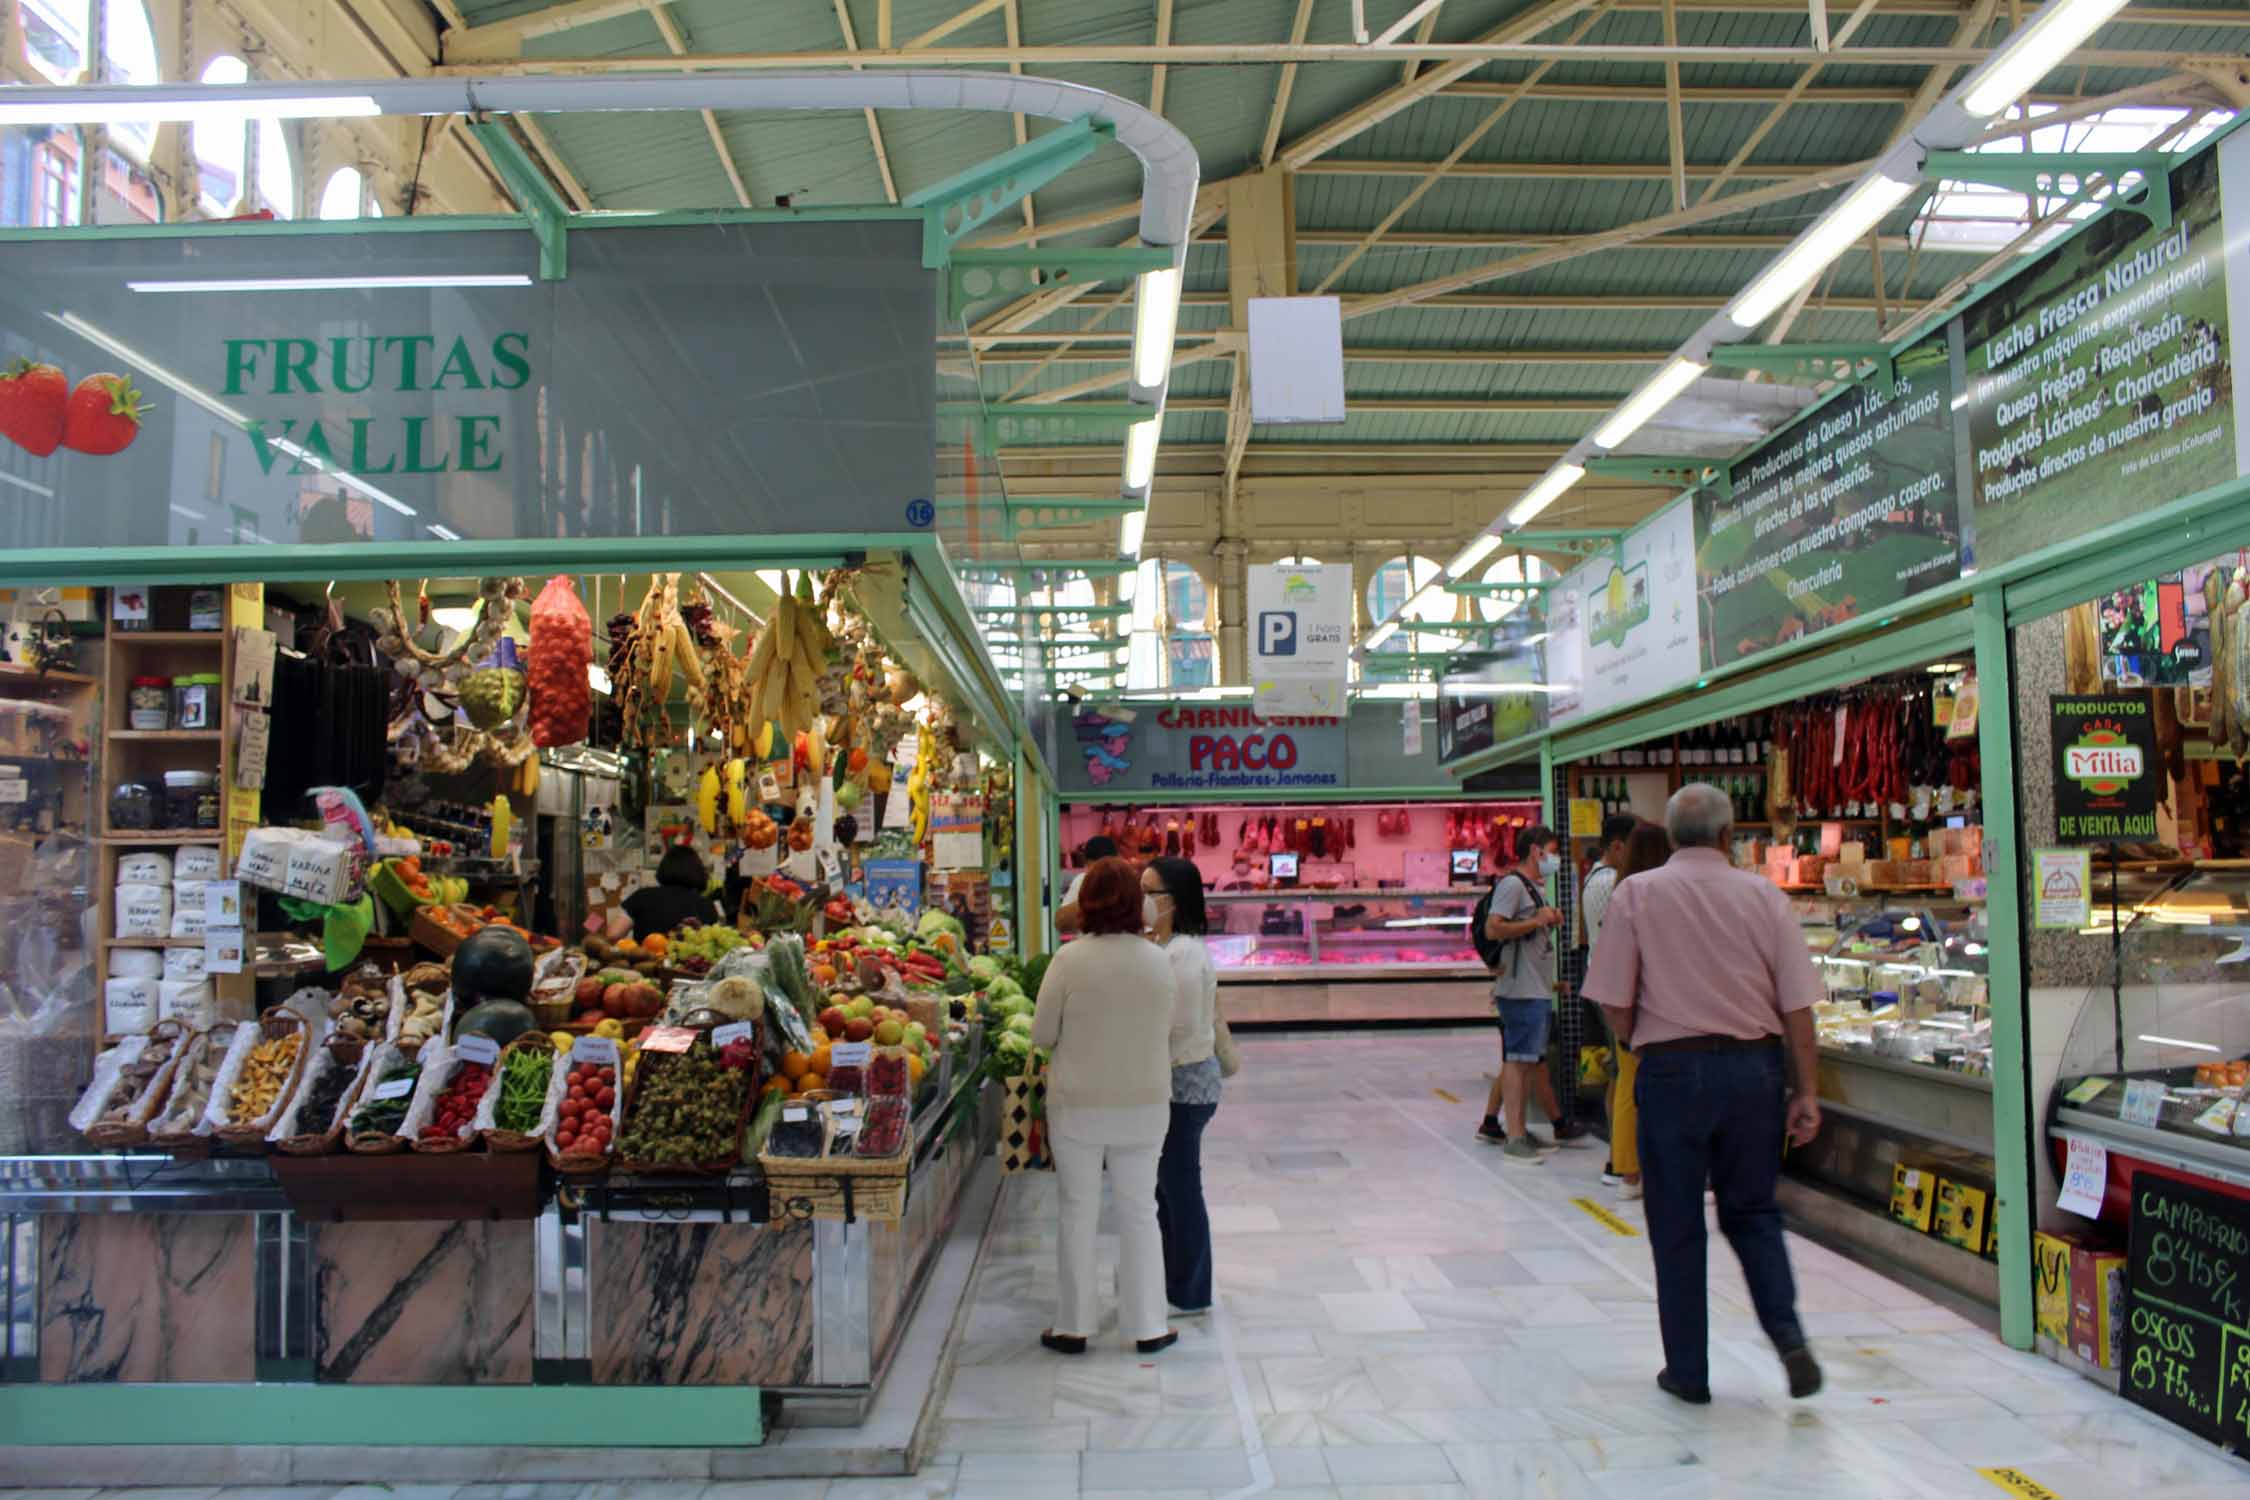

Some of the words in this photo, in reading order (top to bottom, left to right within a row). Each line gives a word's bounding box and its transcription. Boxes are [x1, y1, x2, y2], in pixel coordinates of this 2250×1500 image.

[1986, 322, 2036, 369] Leche
[2039, 283, 2101, 338] Fresca
[2104, 220, 2191, 298] Natural
[1997, 354, 2041, 386] nuestra
[2042, 319, 2100, 365] máquina
[2102, 256, 2209, 330] expendedora)
[221, 332, 531, 396] FRUTAS
[1996, 391, 2039, 427] Queso
[2040, 365, 2087, 402] Fresco
[2100, 311, 2183, 374] Requesón
[1751, 440, 1804, 486] Productores
[1804, 431, 1819, 452] de
[1819, 414, 1853, 444] Queso
[1854, 405, 1862, 427] y
[1863, 376, 1912, 417] Lácos,
[1978, 426, 2042, 474] Productos
[2044, 398, 2099, 440] Lácteos
[2114, 334, 2217, 407] Charcutería
[247, 415, 503, 476] VALLE
[1795, 455, 1834, 490] mejores
[1835, 431, 1874, 468] quesos
[1875, 388, 1940, 442] asturianos
[1984, 467, 2038, 504] Productos
[2039, 444, 2086, 480] directos
[2088, 433, 2105, 457] de
[2107, 411, 2160, 448] nuestra
[2162, 384, 2213, 430] granja
[1754, 504, 1789, 539] directos
[1790, 498, 1804, 520] de
[1799, 524, 1836, 555] nuestro
[1837, 493, 1896, 536] compango
[1898, 471, 1946, 506] casero.
[1263, 613, 1293, 654] P
[1306, 634, 1341, 644] GRATIS
[2055, 702, 2146, 716] PRODUCTOS
[2082, 718, 2123, 734] CASA
[1189, 732, 1298, 772] PACO
[2071, 751, 2137, 774] Milia
[2059, 815, 2076, 836] DE
[2078, 815, 2121, 837] VENTA
[2123, 811, 2156, 836] AQUÍ
[2131, 1306, 2196, 1359] OSCOS
